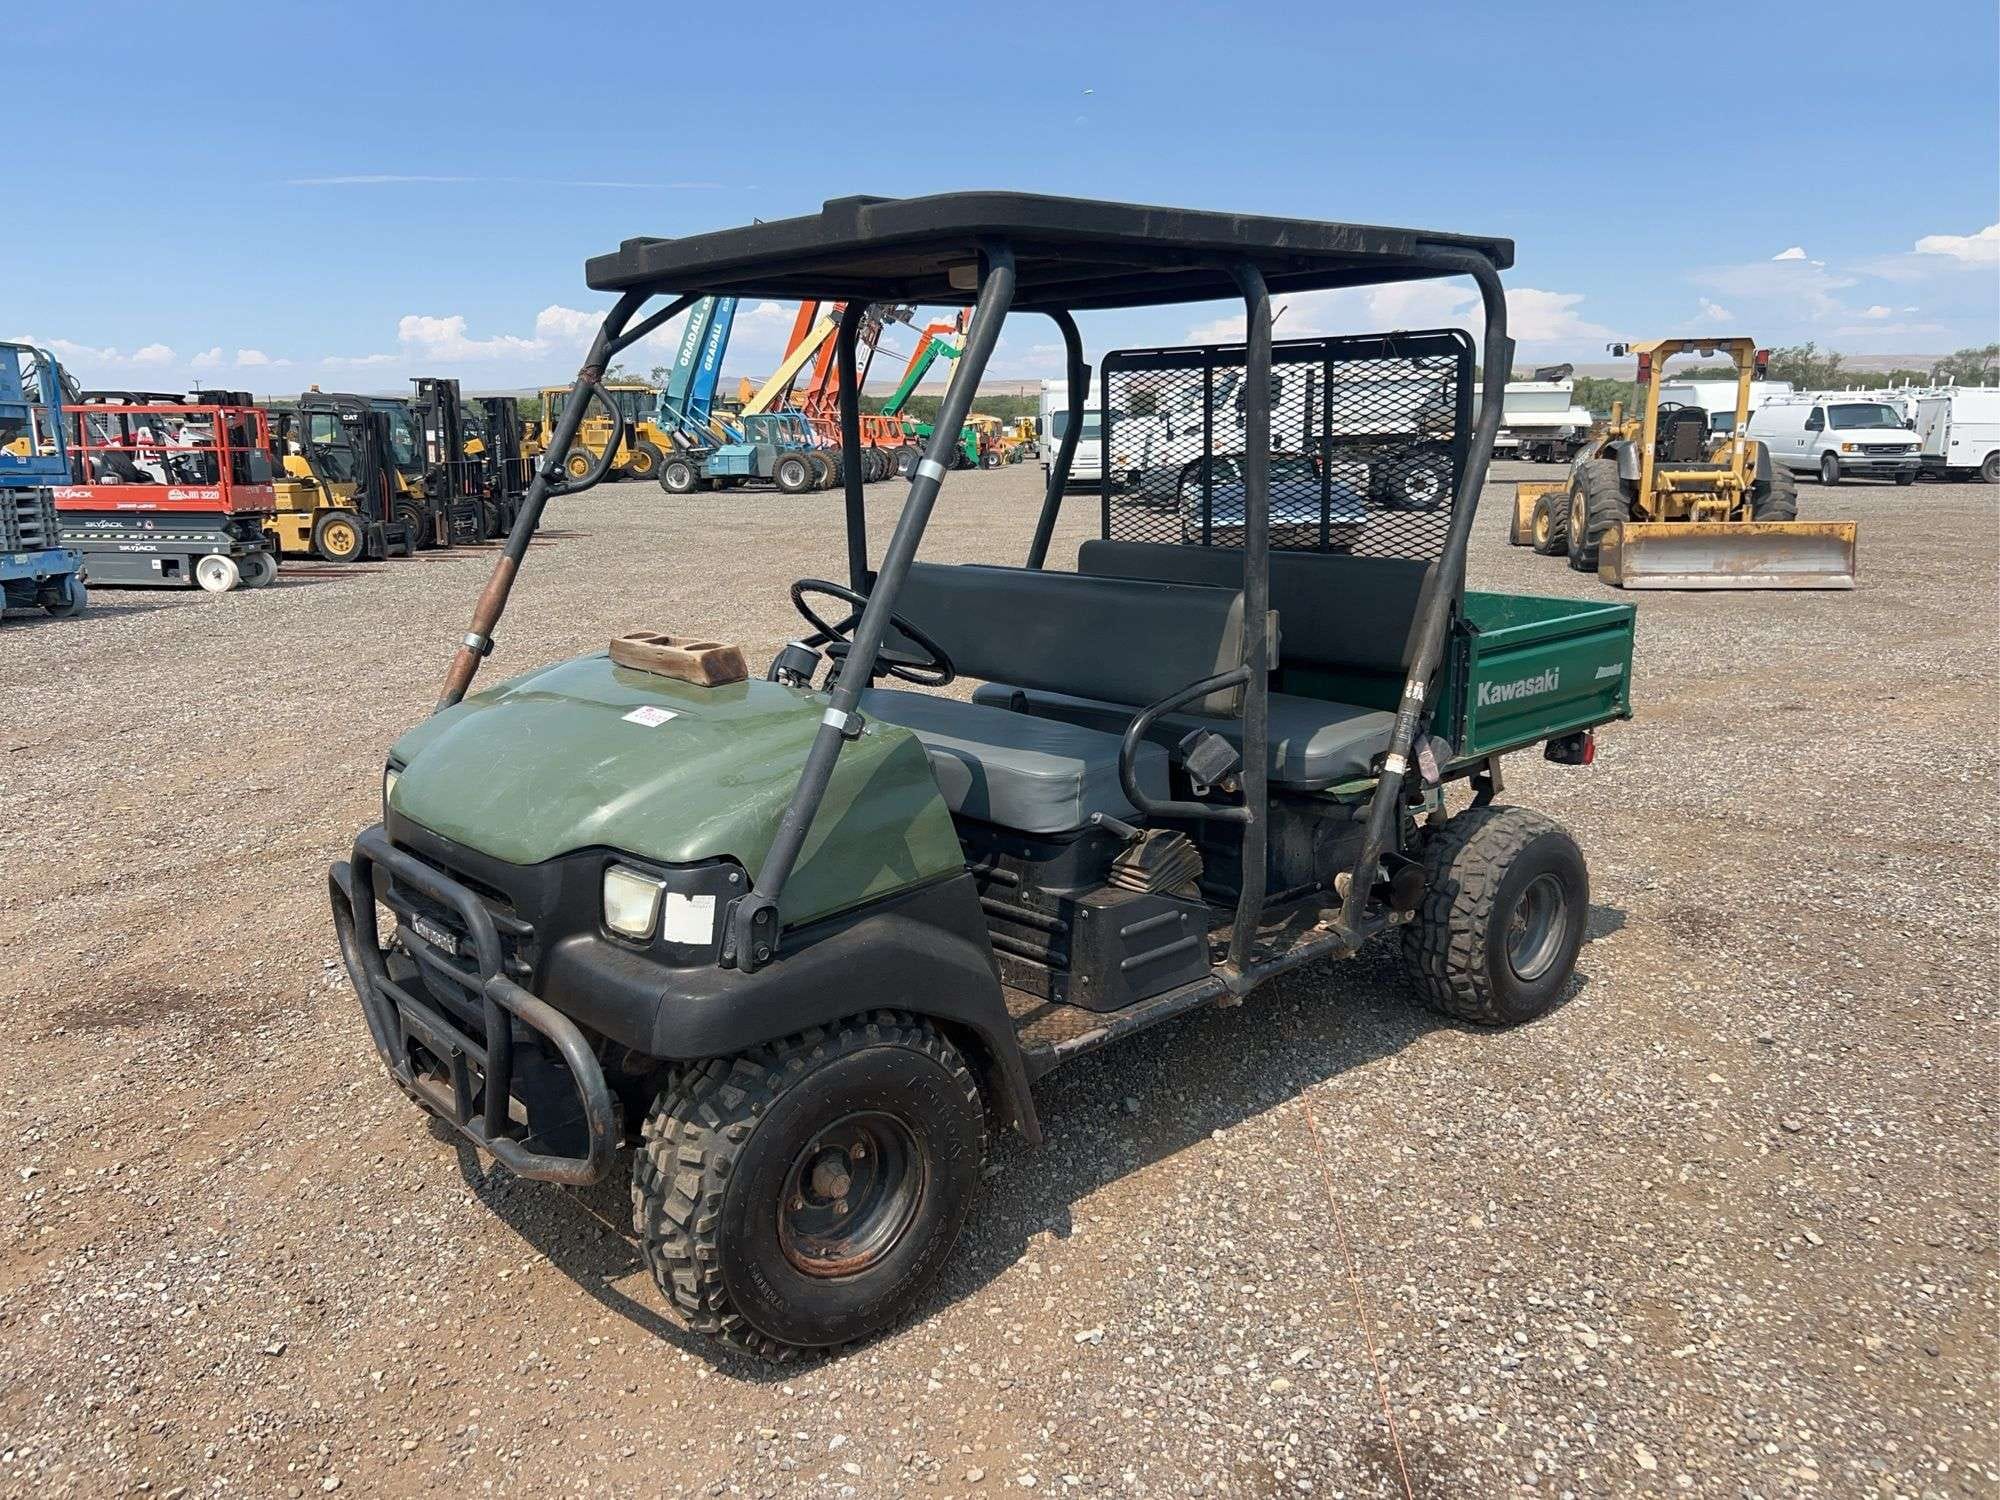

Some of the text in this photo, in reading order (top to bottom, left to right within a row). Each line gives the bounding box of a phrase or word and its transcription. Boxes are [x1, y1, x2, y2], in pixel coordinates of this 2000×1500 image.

[680, 312, 704, 367] GRADALL
[704, 323, 723, 371] GRADALL
[54, 488, 94, 499] KYJACK
[85, 520, 124, 528] SKYJACK
[119, 543, 158, 552] SKYJACK
[1477, 667, 1560, 707] Kawasaki
